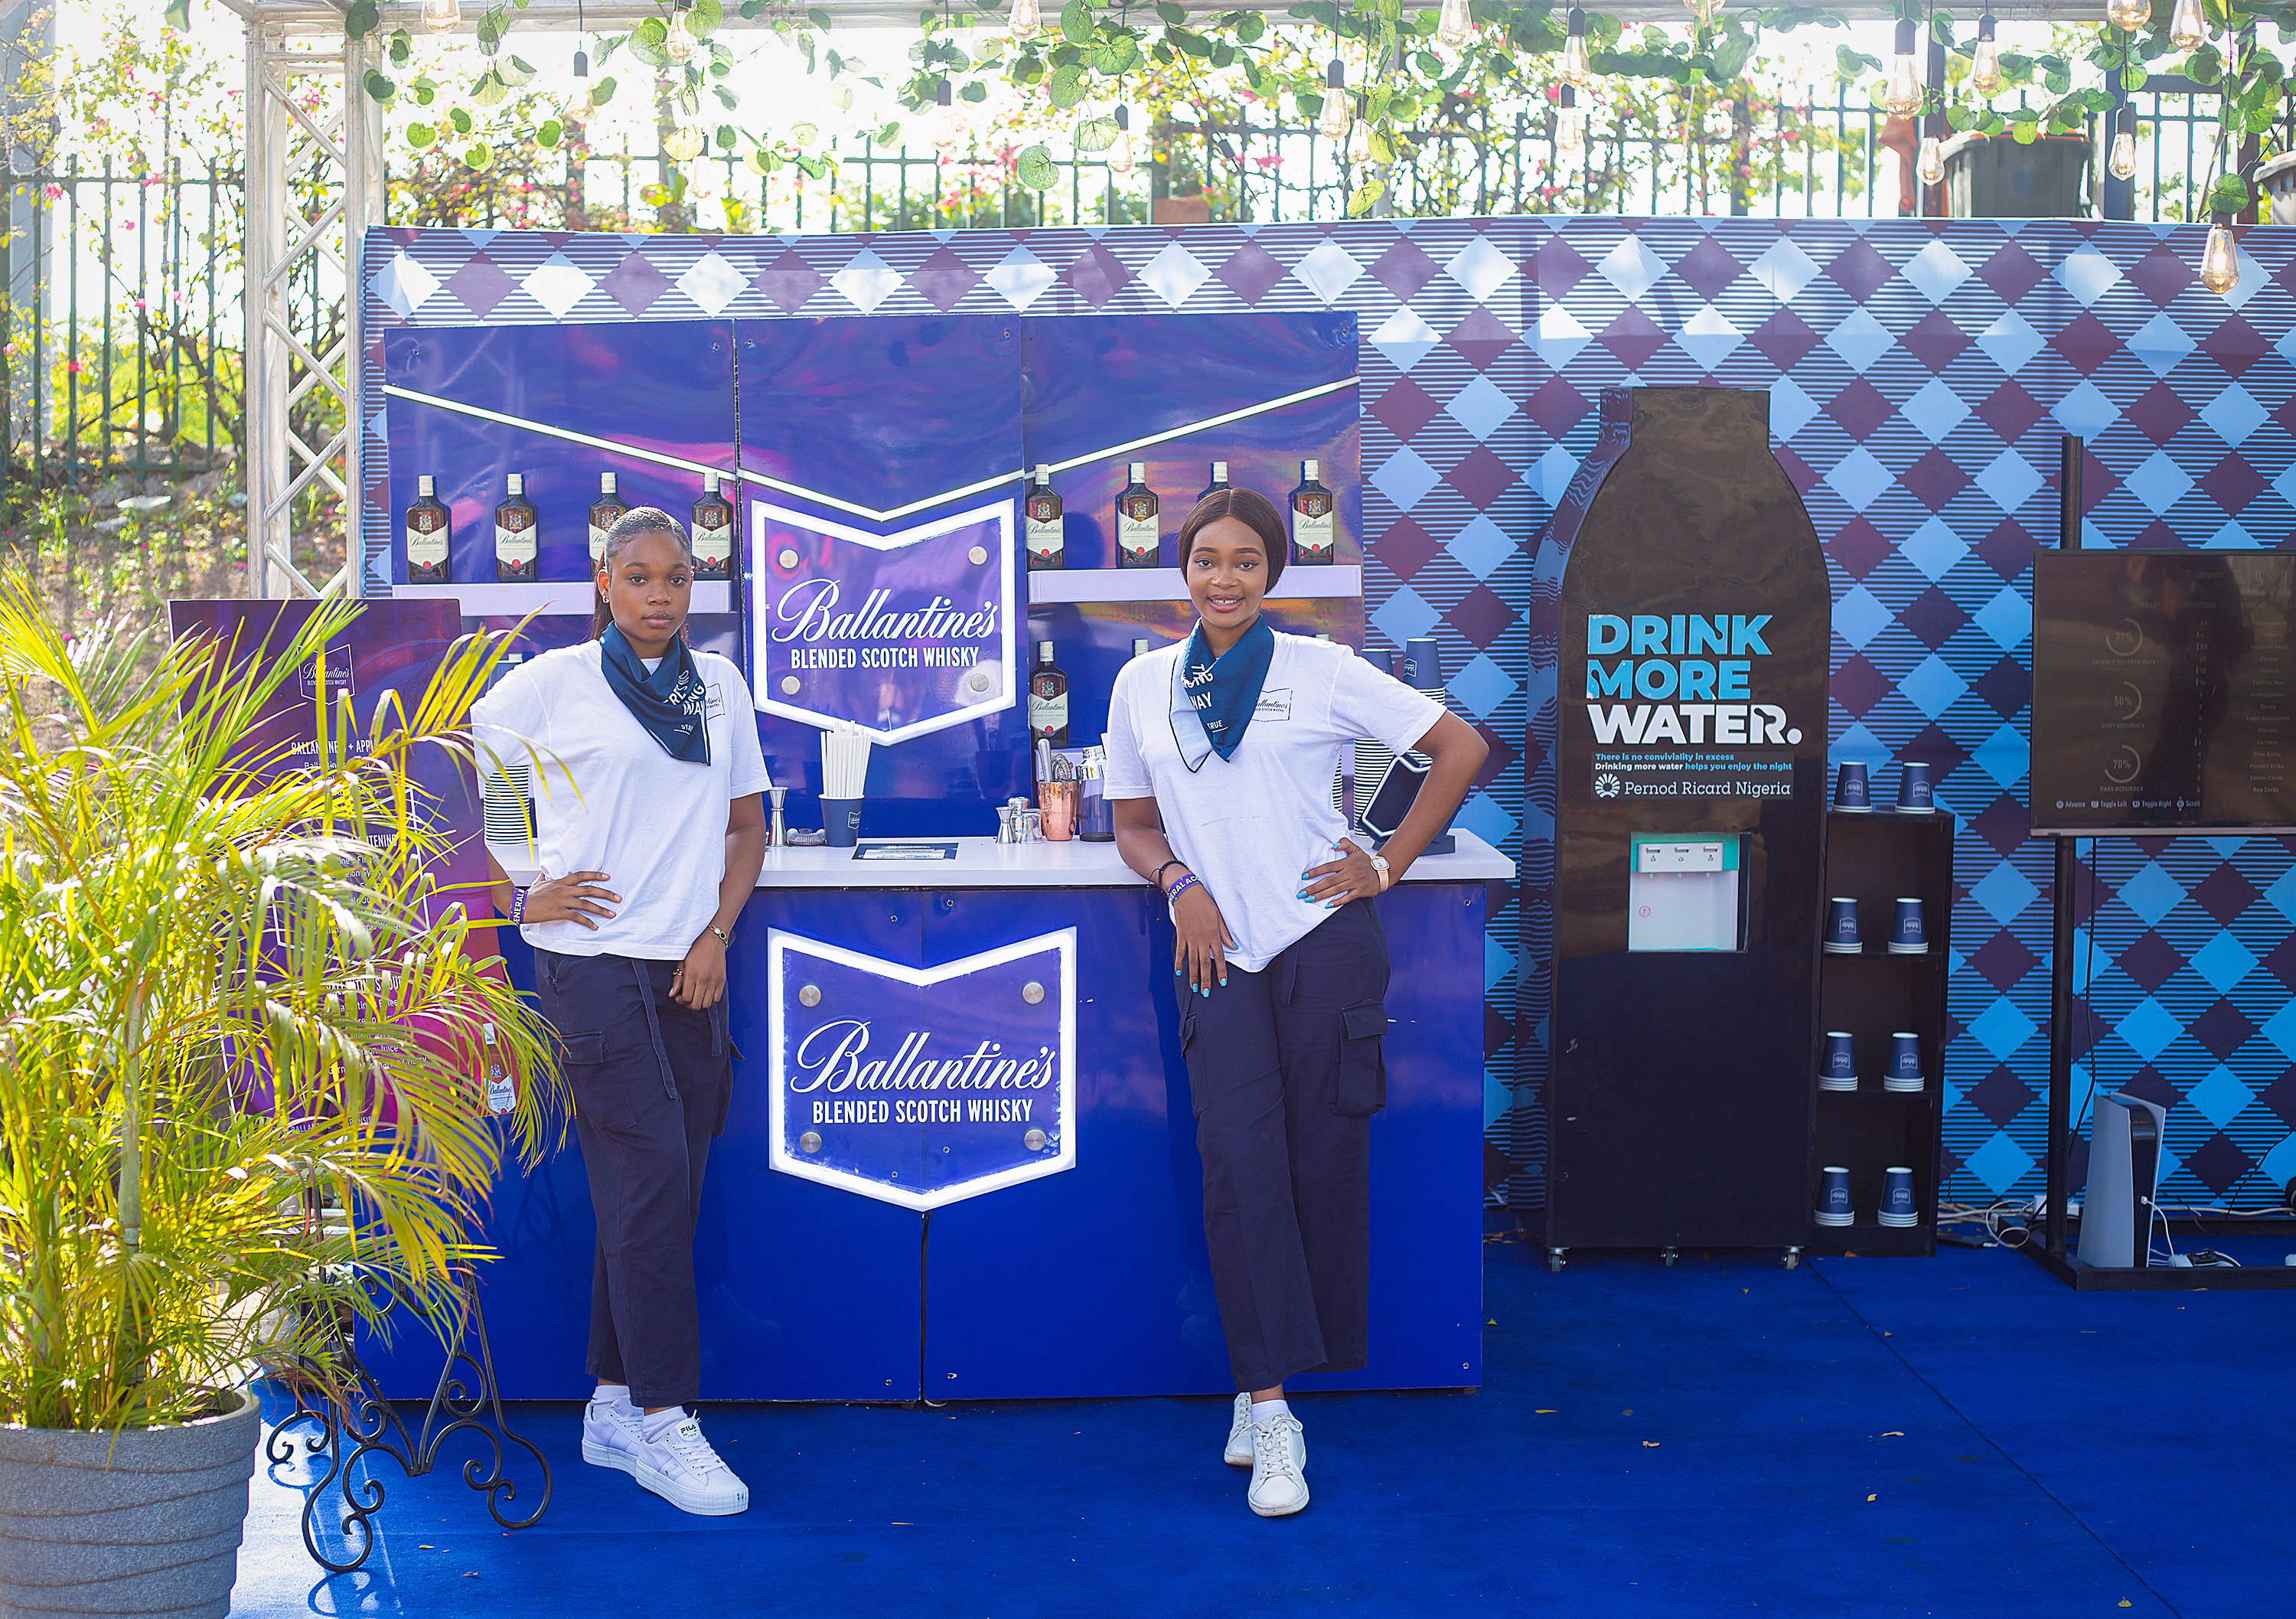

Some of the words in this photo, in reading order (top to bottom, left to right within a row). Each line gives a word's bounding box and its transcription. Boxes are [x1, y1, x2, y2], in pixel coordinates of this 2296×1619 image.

[1027, 524, 1062, 534] Ballantine's
[1123, 521, 1157, 532] Ballantine's
[1298, 519, 1332, 530] Ballantine's
[409, 536, 443, 546] Ballantine's
[498, 534, 533, 544] Ballantine's
[695, 531, 729, 542] Ballantine's
[771, 578, 998, 642] Ballantine's
[1587, 614, 1773, 655] DRINK
[2115, 632, 2134, 642] 77%
[791, 648, 857, 669] BLENDED
[861, 648, 918, 668] SCOTCH
[923, 646, 980, 668] WHISKY
[1586, 658, 1751, 700] MORE
[1032, 700, 1065, 711] Ballantine's
[2114, 696, 2132, 706] 50%
[1207, 720, 1223, 730] TRUE
[1587, 704, 1803, 745] WATER.
[1622, 752, 1629, 761] is
[1644, 752, 1694, 762] conviviality
[1695, 752, 1704, 761] in
[1595, 762, 1632, 772] Drinking
[1685, 762, 1708, 772] helps
[1728, 762, 1751, 772] enjoy
[1769, 762, 1792, 772] night
[2113, 759, 2131, 769] 70%
[1624, 781, 1678, 795] Pernod
[1681, 781, 1731, 795] Ricard
[1735, 781, 1791, 798] Nigeria
[2100, 801, 2116, 809] Toggle
[2141, 801, 2157, 809] Toggle
[790, 1020, 1056, 1092] Ballantine's
[813, 1100, 889, 1124] BLENDED
[895, 1099, 961, 1123] SCOTCH
[967, 1098, 1033, 1122] WHISKY
[680, 1424, 696, 1434] FILA
